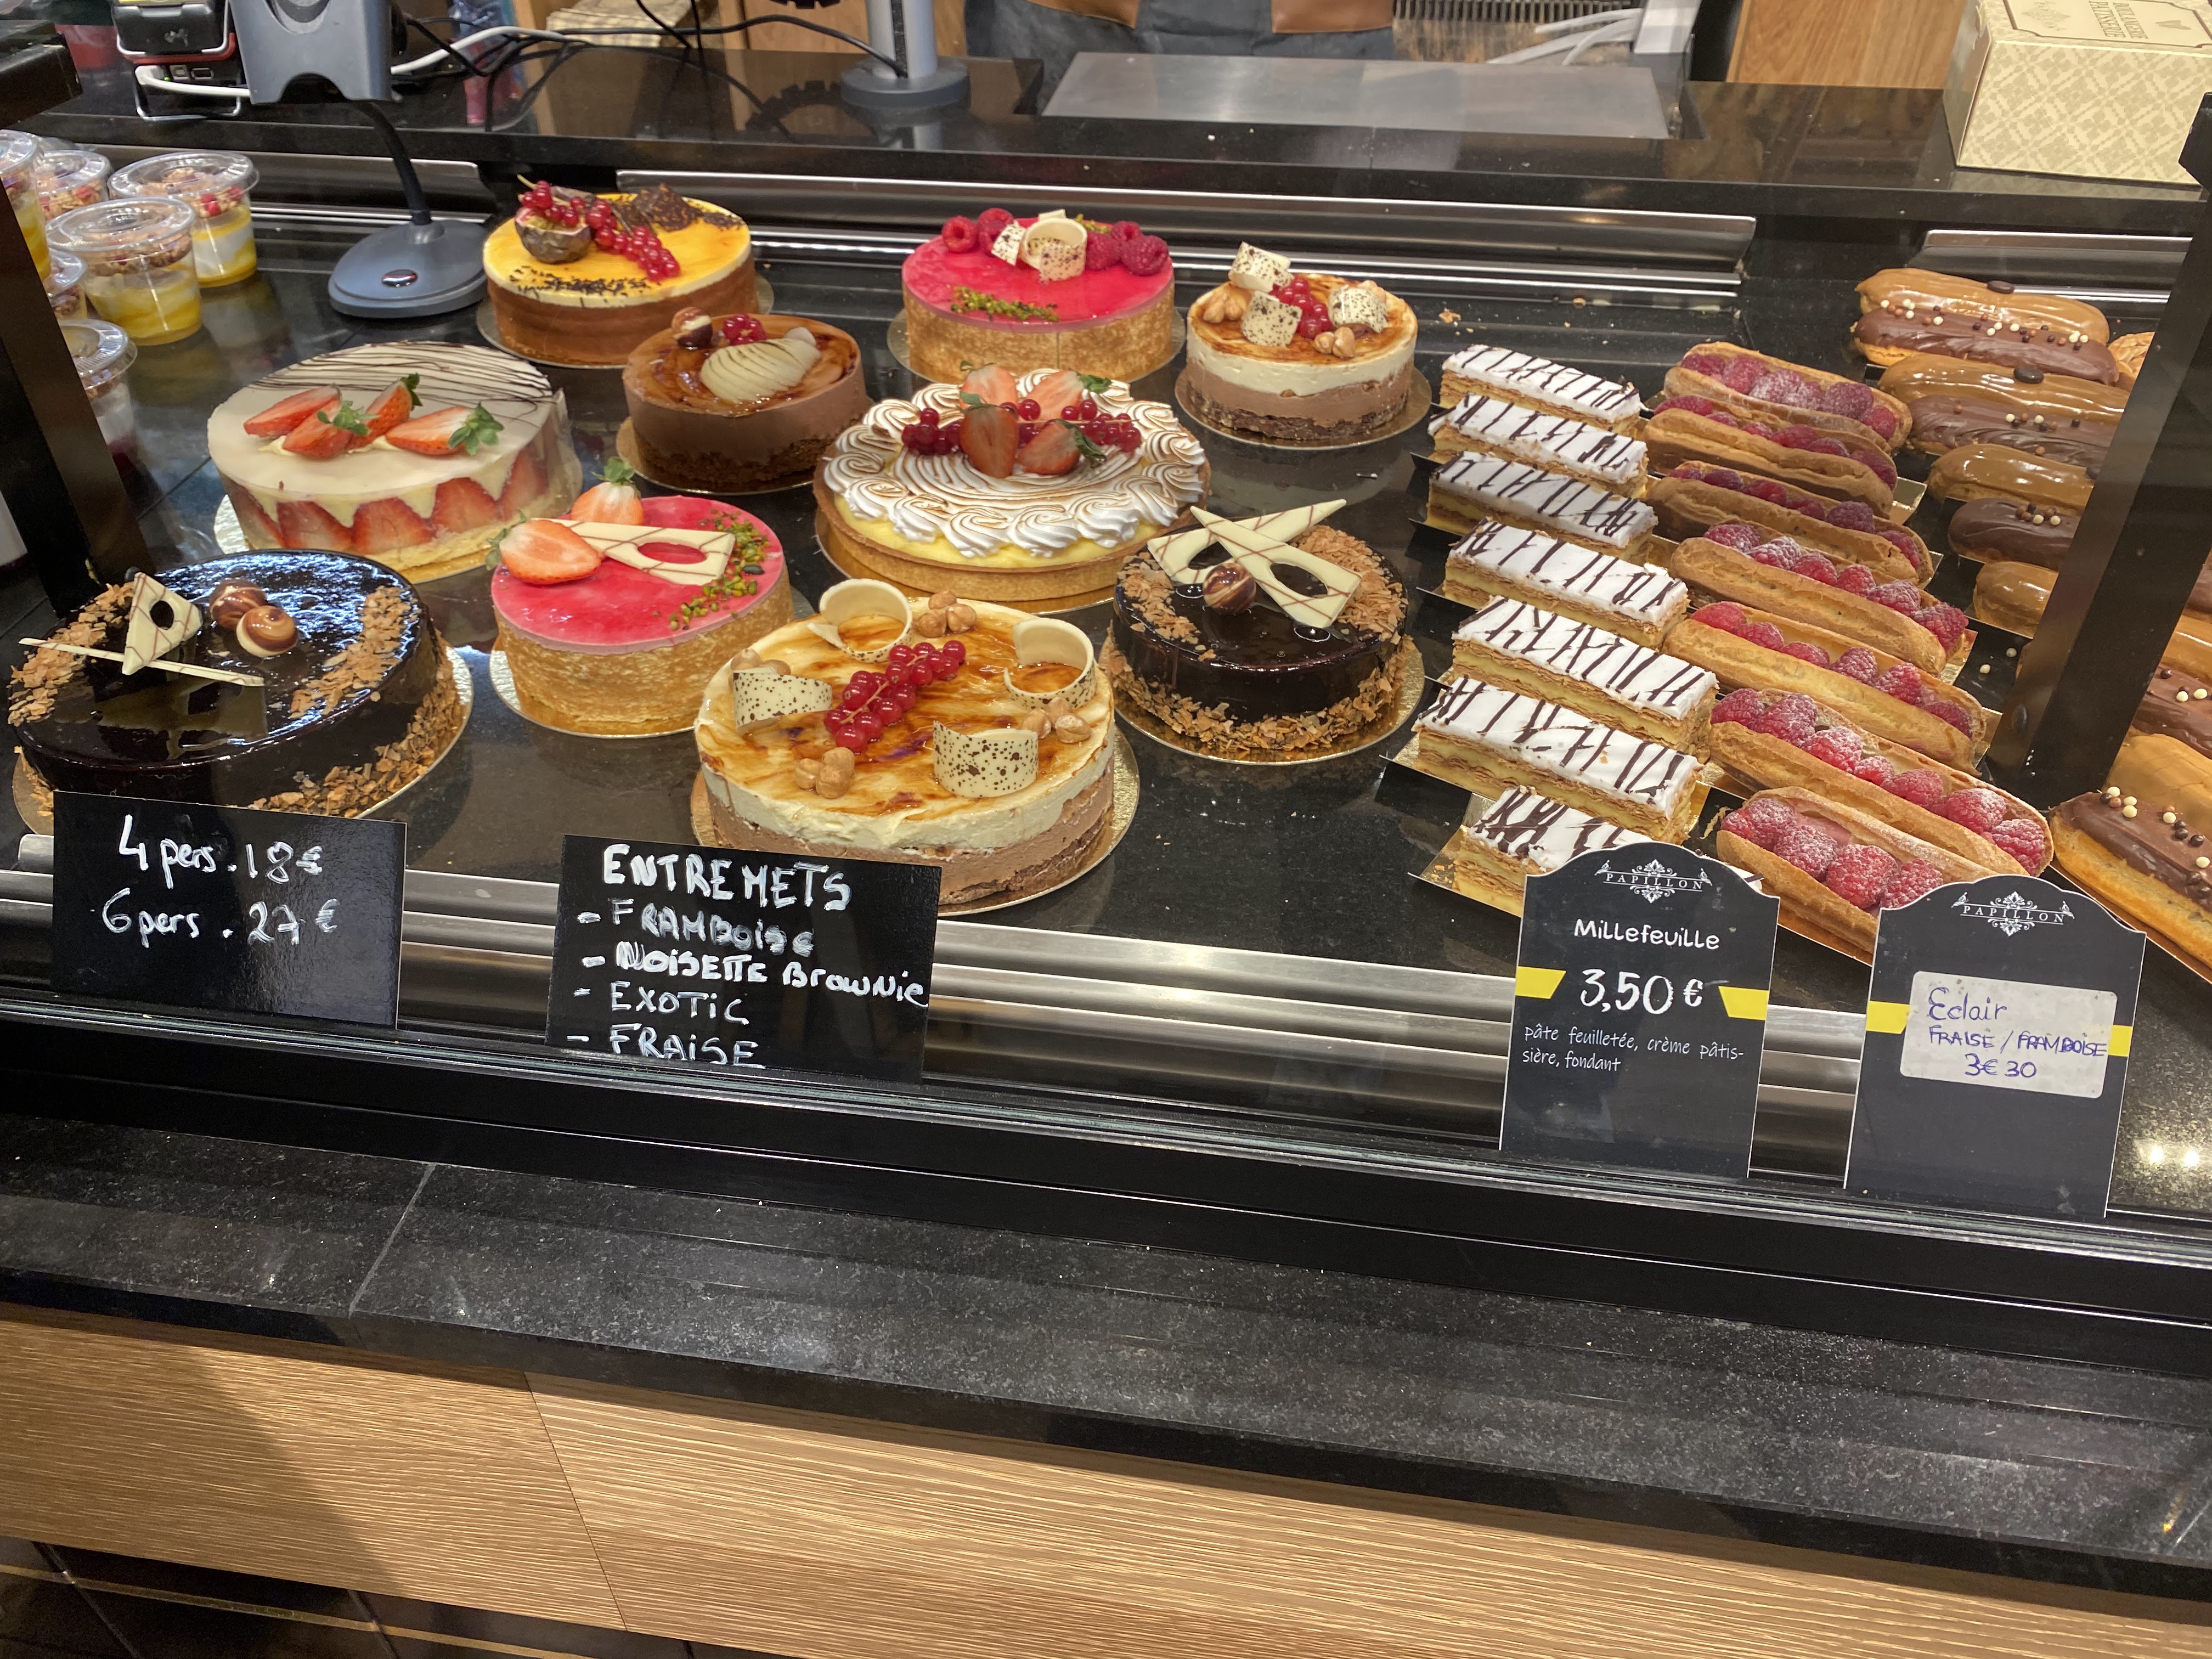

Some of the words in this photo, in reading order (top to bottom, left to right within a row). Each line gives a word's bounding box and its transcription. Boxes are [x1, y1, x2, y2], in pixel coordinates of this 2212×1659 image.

[119, 814, 149, 871] 4
[604, 844, 851, 911] ENTREMETS
[1606, 873, 1703, 889] PAPILLON
[1963, 906, 2064, 922] PAPILLON
[1575, 919, 1720, 950] Millefeuille
[1581, 969, 1674, 1014] 3,50
[1683, 979, 1703, 1007] €
[1525, 1023, 1559, 1041] pâte
[1568, 1026, 1638, 1053] feuilletée,
[1647, 1037, 1690, 1054] crème
[1700, 1042, 1744, 1060] pâtis-
[1929, 1025, 1995, 1048] FRAISE
[1523, 1048, 1560, 1068] sière,
[1565, 1051, 1622, 1071] fondant
